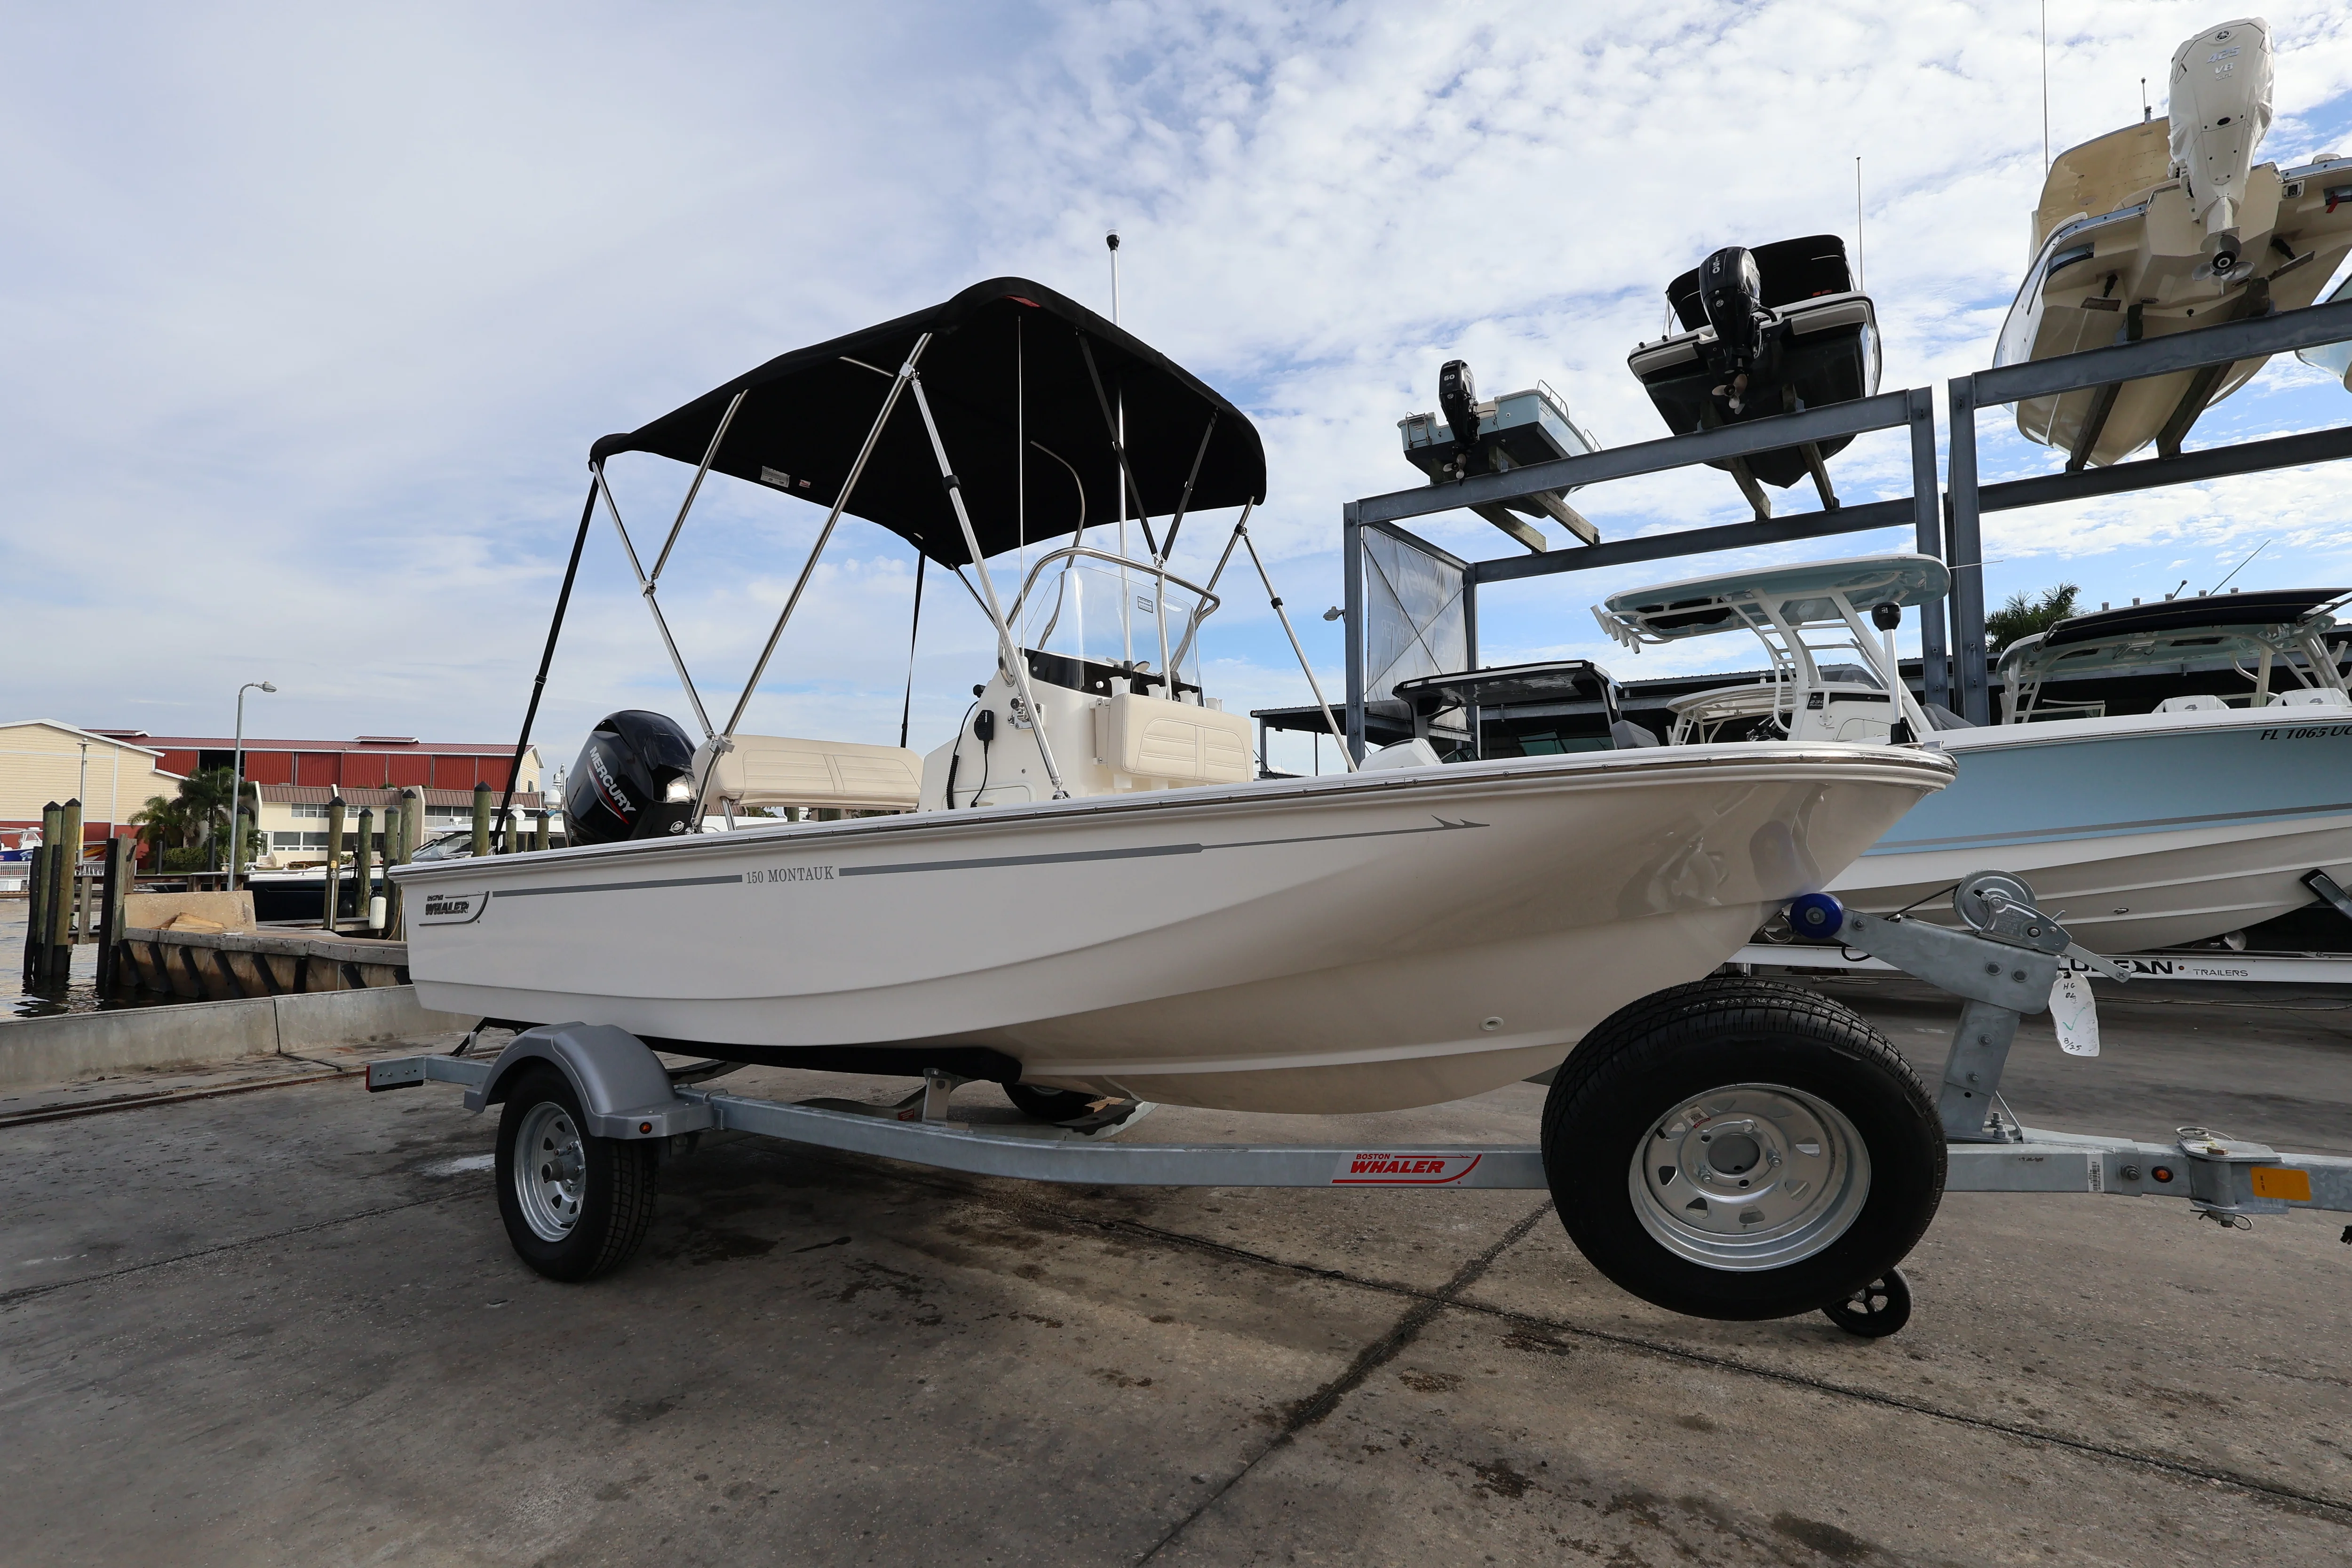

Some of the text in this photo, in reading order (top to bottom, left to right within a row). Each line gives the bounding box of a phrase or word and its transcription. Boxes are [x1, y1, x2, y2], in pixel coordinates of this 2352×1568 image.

[2206, 46, 2241, 64] 425
[2215, 63, 2234, 74] V8
[2260, 729, 2278, 740] FL
[2286, 728, 2328, 739] 1065
[589, 746, 636, 812] MERCURY
[747, 866, 834, 883] 150 MONTAUK
[425, 900, 469, 915] WHALER
[2193, 969, 2249, 977] TRAILERS
[2064, 1037, 2082, 1051] 8/25
[1351, 1161, 1445, 1173] WHALER
